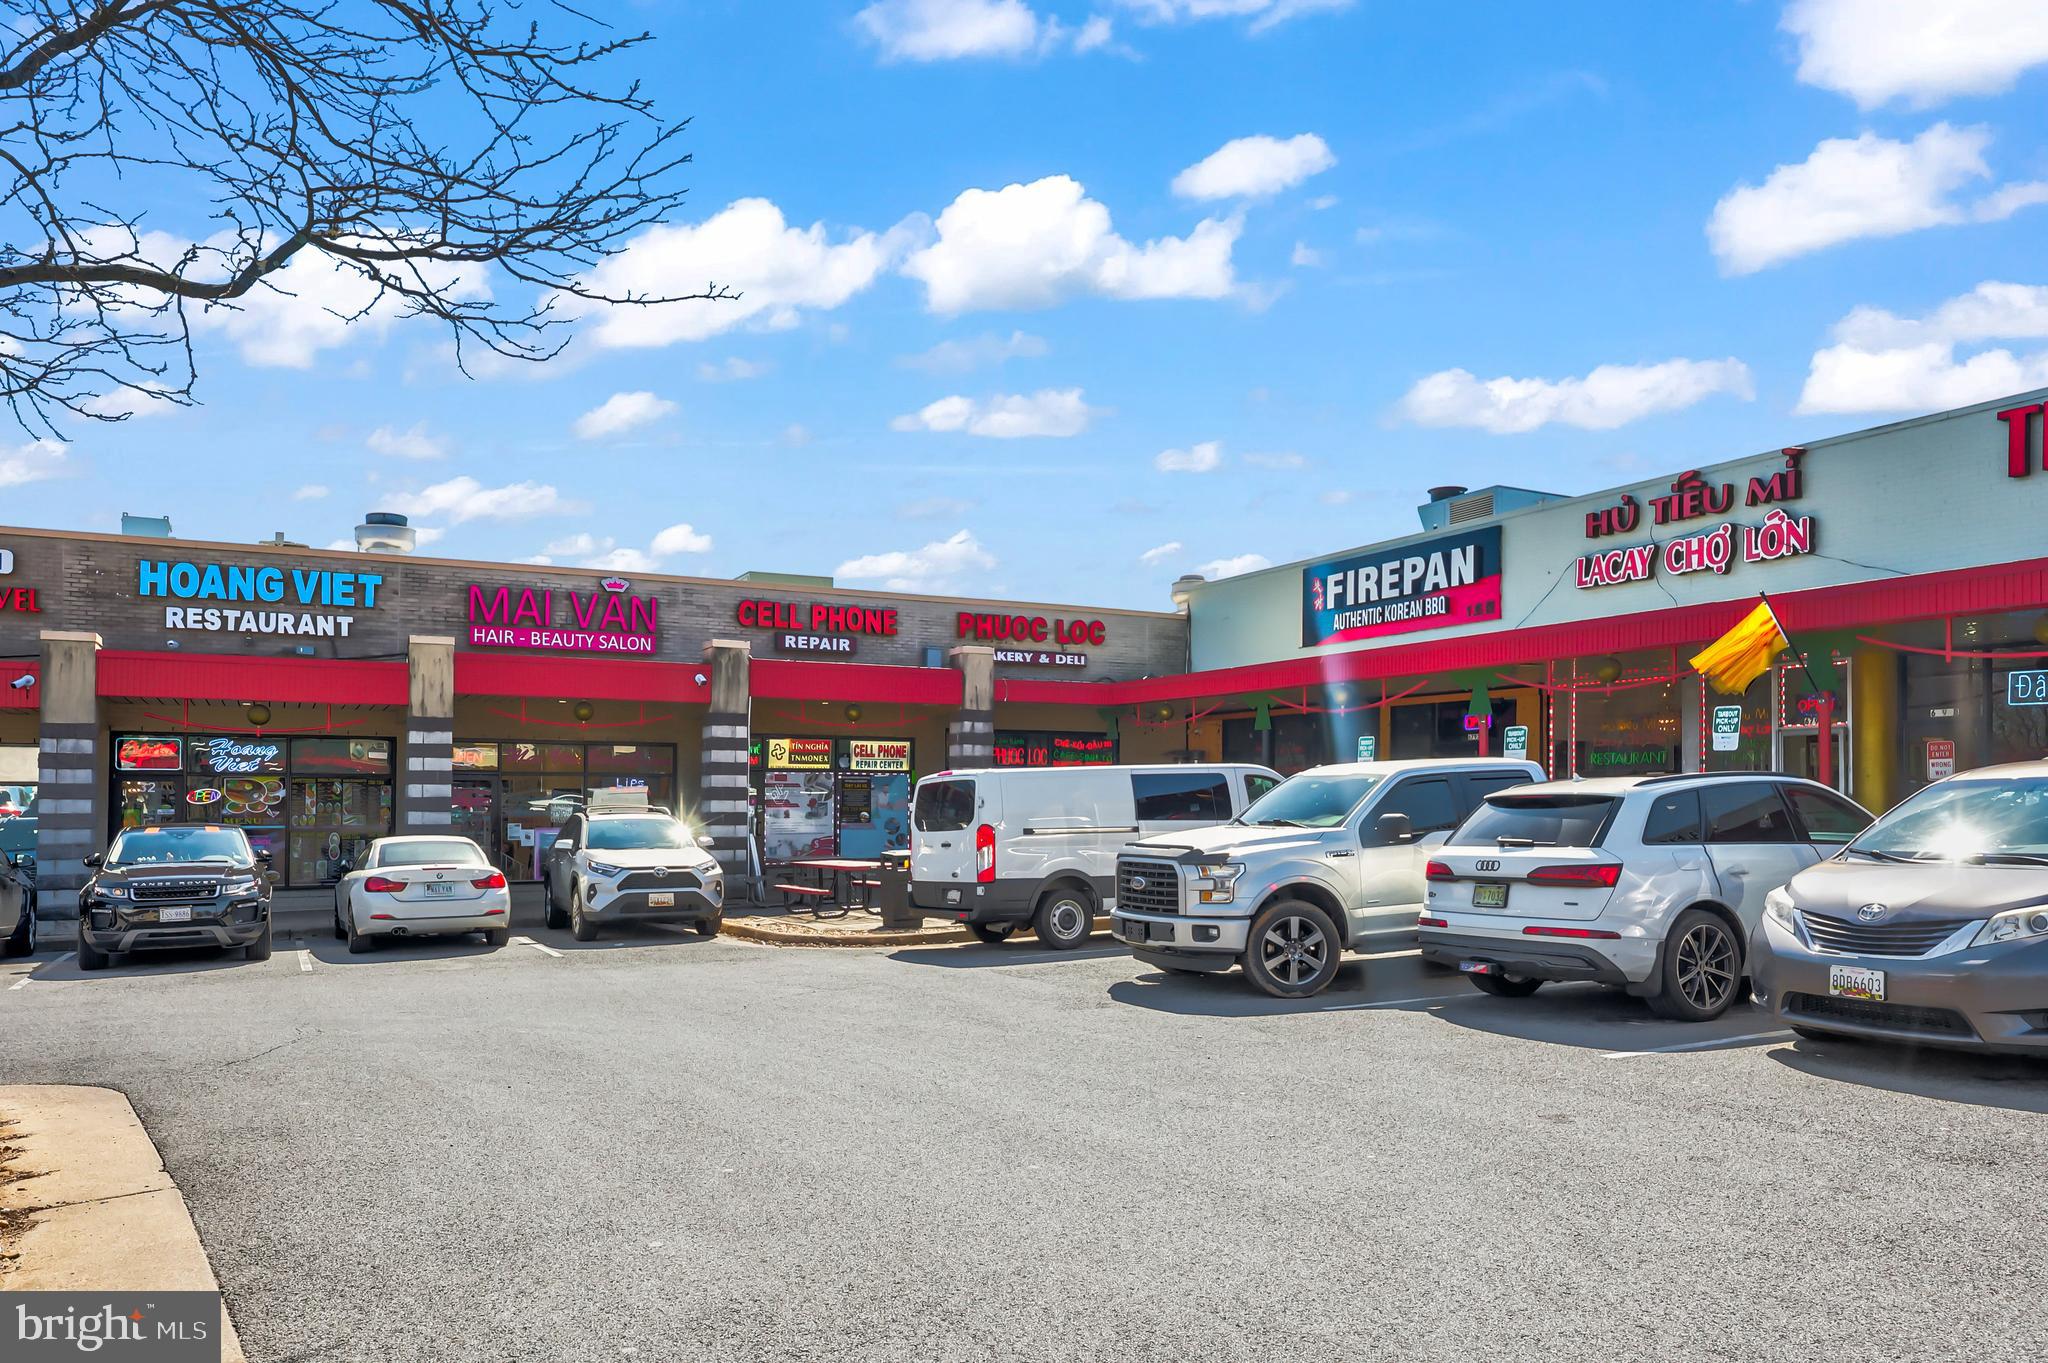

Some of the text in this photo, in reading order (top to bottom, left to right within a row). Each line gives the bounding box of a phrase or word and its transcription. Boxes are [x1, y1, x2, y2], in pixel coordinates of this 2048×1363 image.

[1575, 508, 1811, 589] LACAY CHỢ LỚN
[139, 560, 383, 608] HOANG VIET
[1327, 545, 1475, 609] FIREPAN
[469, 584, 550, 627] MAI
[1333, 606, 1383, 631] AUTHENTIC
[1384, 600, 1423, 623] KOREAN
[1425, 595, 1447, 617] BBQ
[166, 606, 354, 637] RESTAURANT
[738, 600, 898, 636] CELL PHONE
[958, 612, 1106, 646] PHUOC LOC
[474, 628, 514, 645] HAIR
[531, 631, 595, 648] BEAUTY
[599, 635, 651, 651] SALON
[785, 635, 850, 651] REPAIR
[1039, 654, 1050, 664] &
[1055, 654, 1085, 665] DELI
[1717, 724, 1736, 733] ONLY
[209, 738, 278, 761] Hoang
[853, 744, 907, 759] CELL PHONE
[1508, 742, 1522, 750] ONLY
[209, 755, 261, 772] Viet
[791, 754, 829, 762] TNMONEX
[855, 760, 904, 769] REPAIR CENTER
[1591, 750, 1668, 766] RESTAURANT
[1935, 769, 1947, 777] WAY
